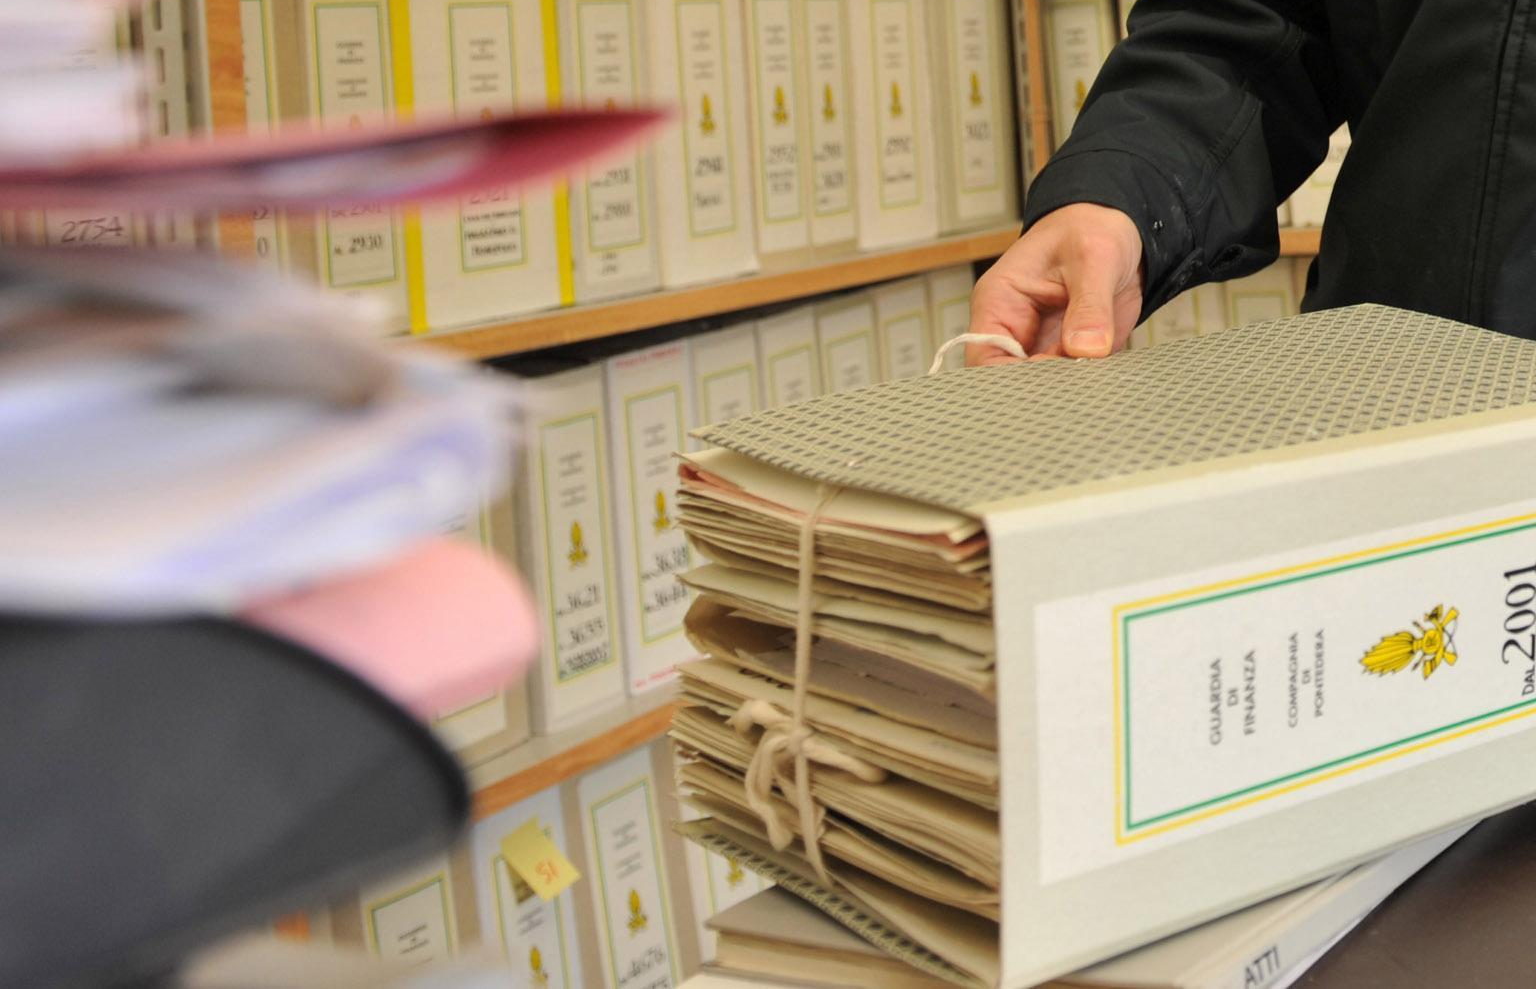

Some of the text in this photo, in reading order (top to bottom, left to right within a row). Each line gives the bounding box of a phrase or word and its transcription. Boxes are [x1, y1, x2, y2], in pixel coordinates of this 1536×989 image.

[1209, 658, 1222, 745] GUARDIA
[1227, 687, 1238, 707] DI
[1243, 649, 1255, 736] FINANZA
[1288, 631, 1298, 728] COMPAGNIA
[1302, 669, 1310, 684] DI
[1314, 627, 1324, 717] PONTEDERA
[1521, 664, 1535, 697] DAL
[1245, 945, 1280, 989] ATTI
